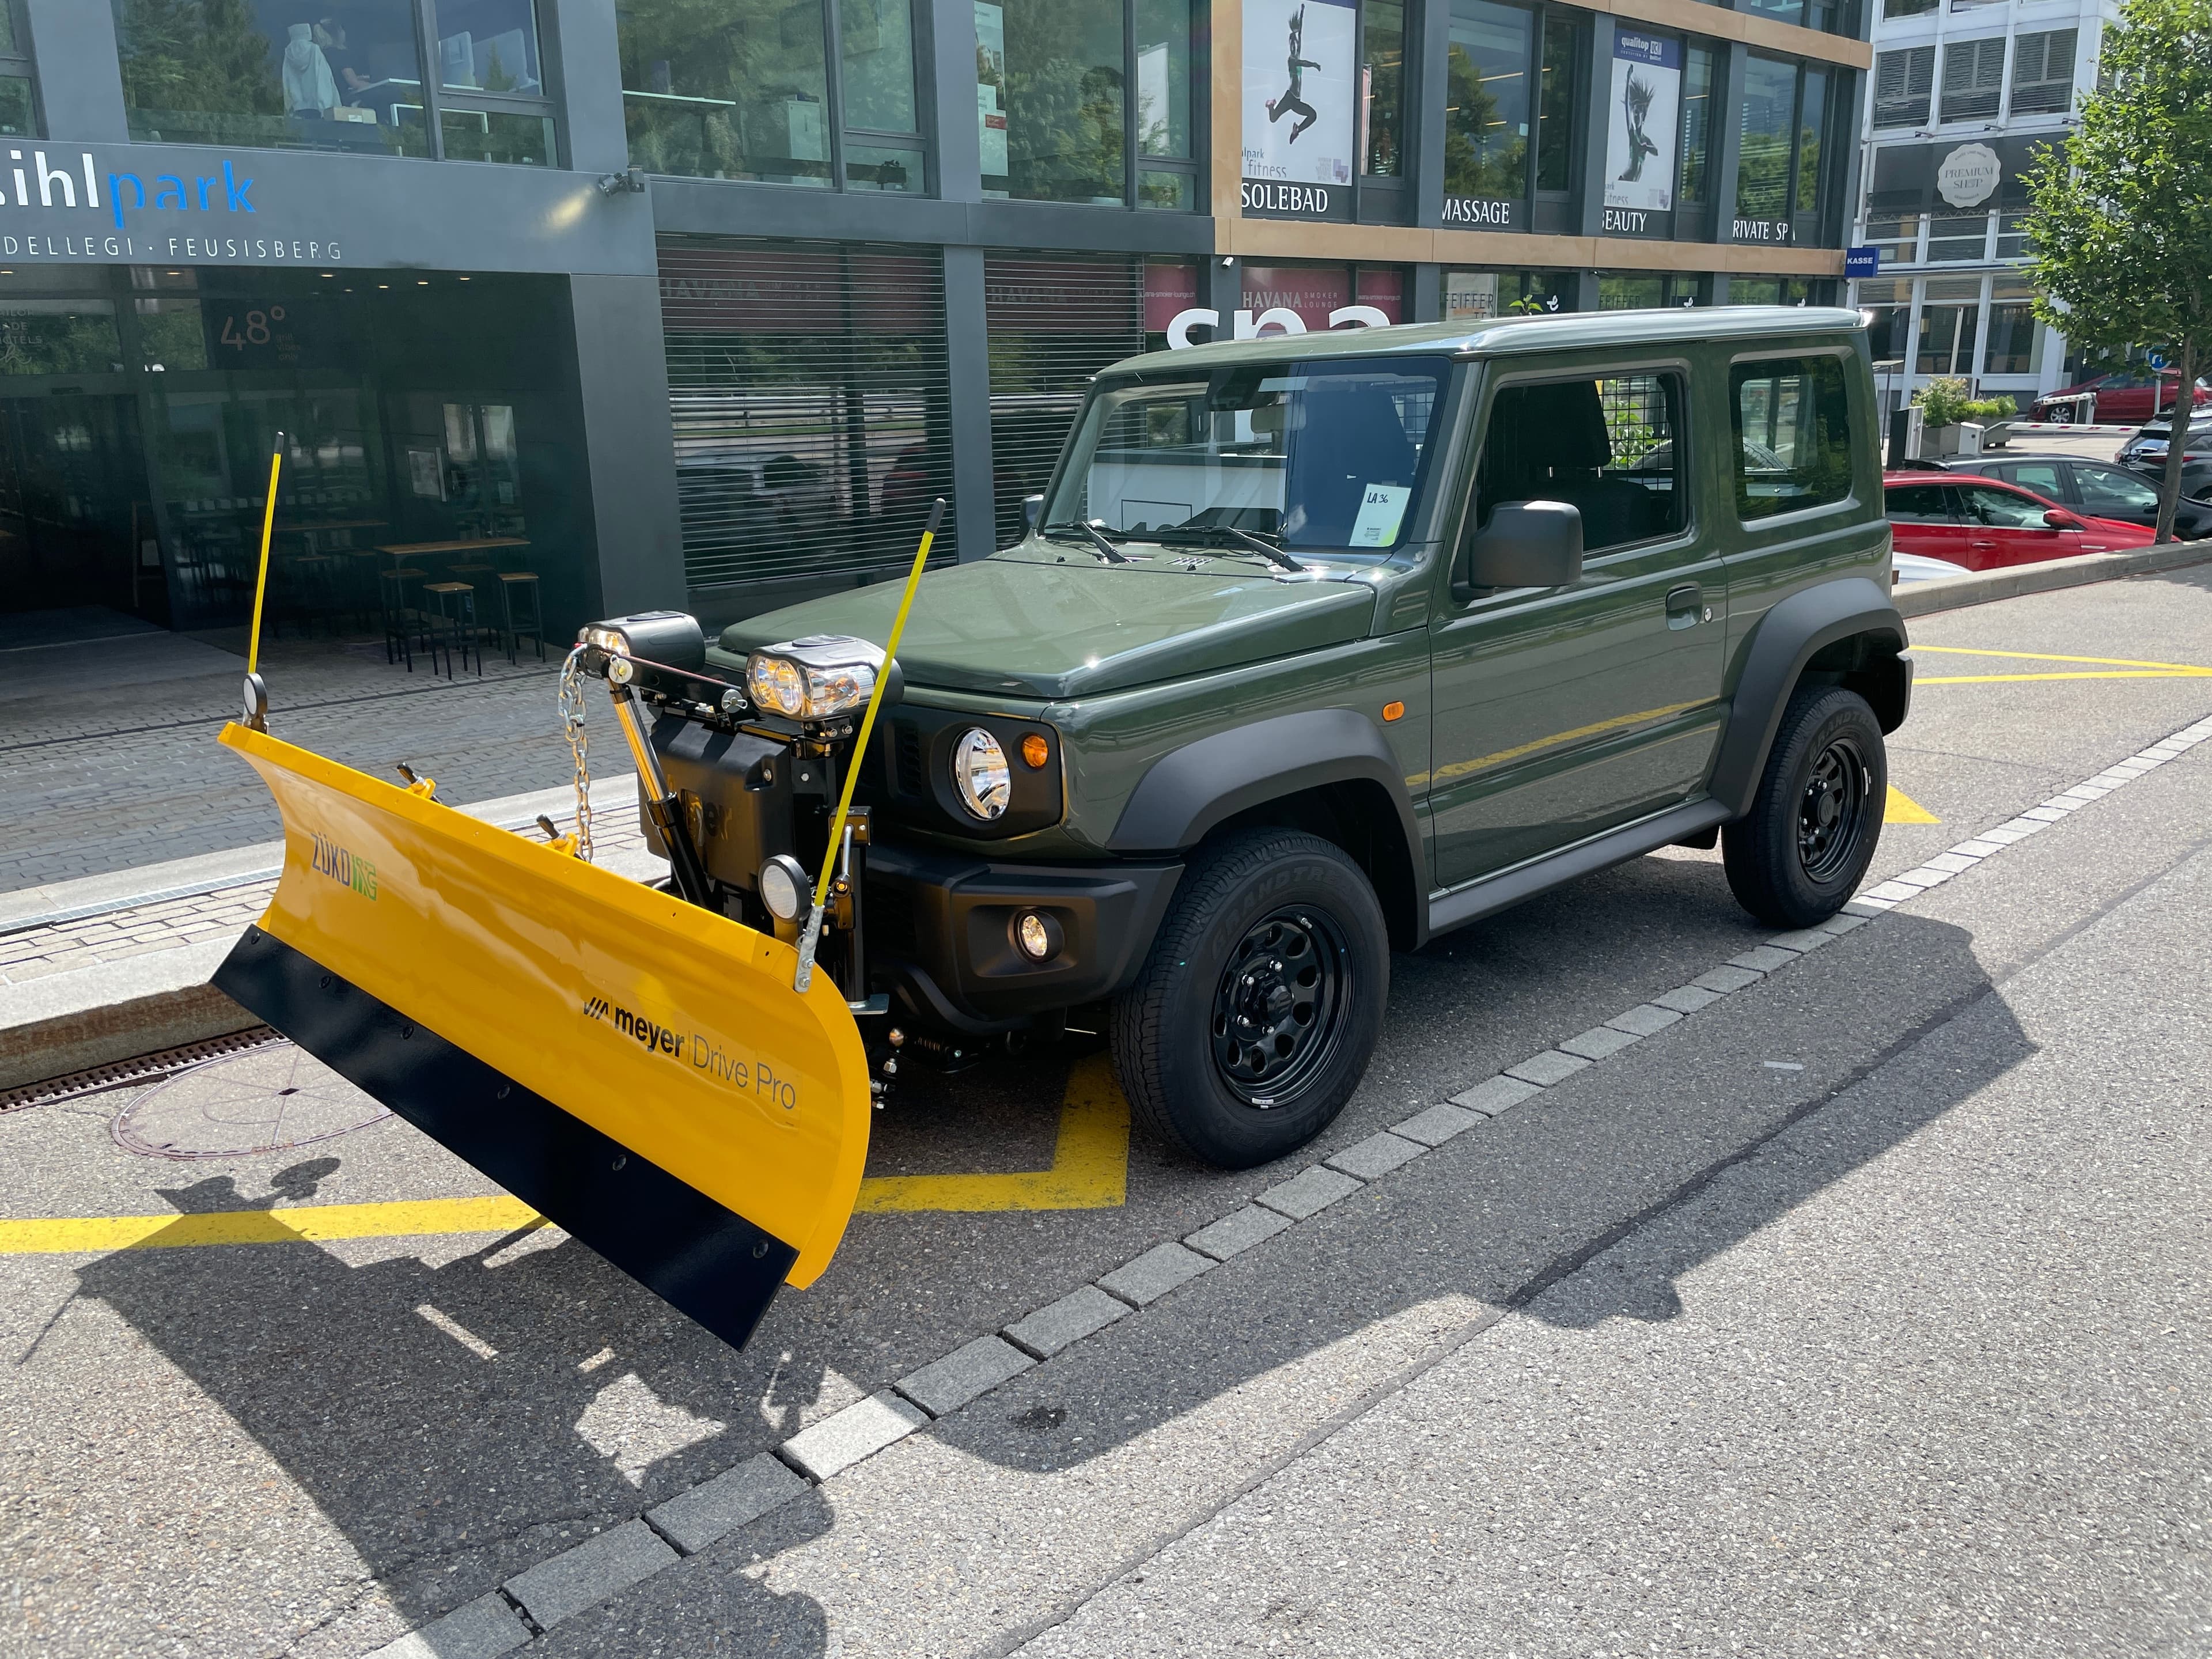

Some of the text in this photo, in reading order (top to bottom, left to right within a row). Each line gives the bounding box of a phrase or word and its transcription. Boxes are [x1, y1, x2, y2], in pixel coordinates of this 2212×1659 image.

[1621, 37, 1649, 52] qualitop
[1248, 160, 1287, 178] fitness
[1945, 166, 1994, 179] PREMIUM
[0, 149, 256, 229] ihlpark
[1953, 178, 1983, 189] SHOP
[1241, 182, 1328, 213] SOLEBAD
[1442, 198, 1510, 225] MASSAGE
[1602, 210, 1647, 232] EAUTY
[168, 237, 342, 260] FEUSISBERG
[1847, 256, 1873, 265] KASSE
[1242, 291, 1338, 308] HAVANA SMOKER
[1304, 301, 1338, 309] LOUNGE
[0, 321, 28, 331] ADE
[0, 335, 43, 344] OTELS
[1367, 492, 1389, 504] LA 36
[615, 1006, 797, 1110] meyer Drive Pro
